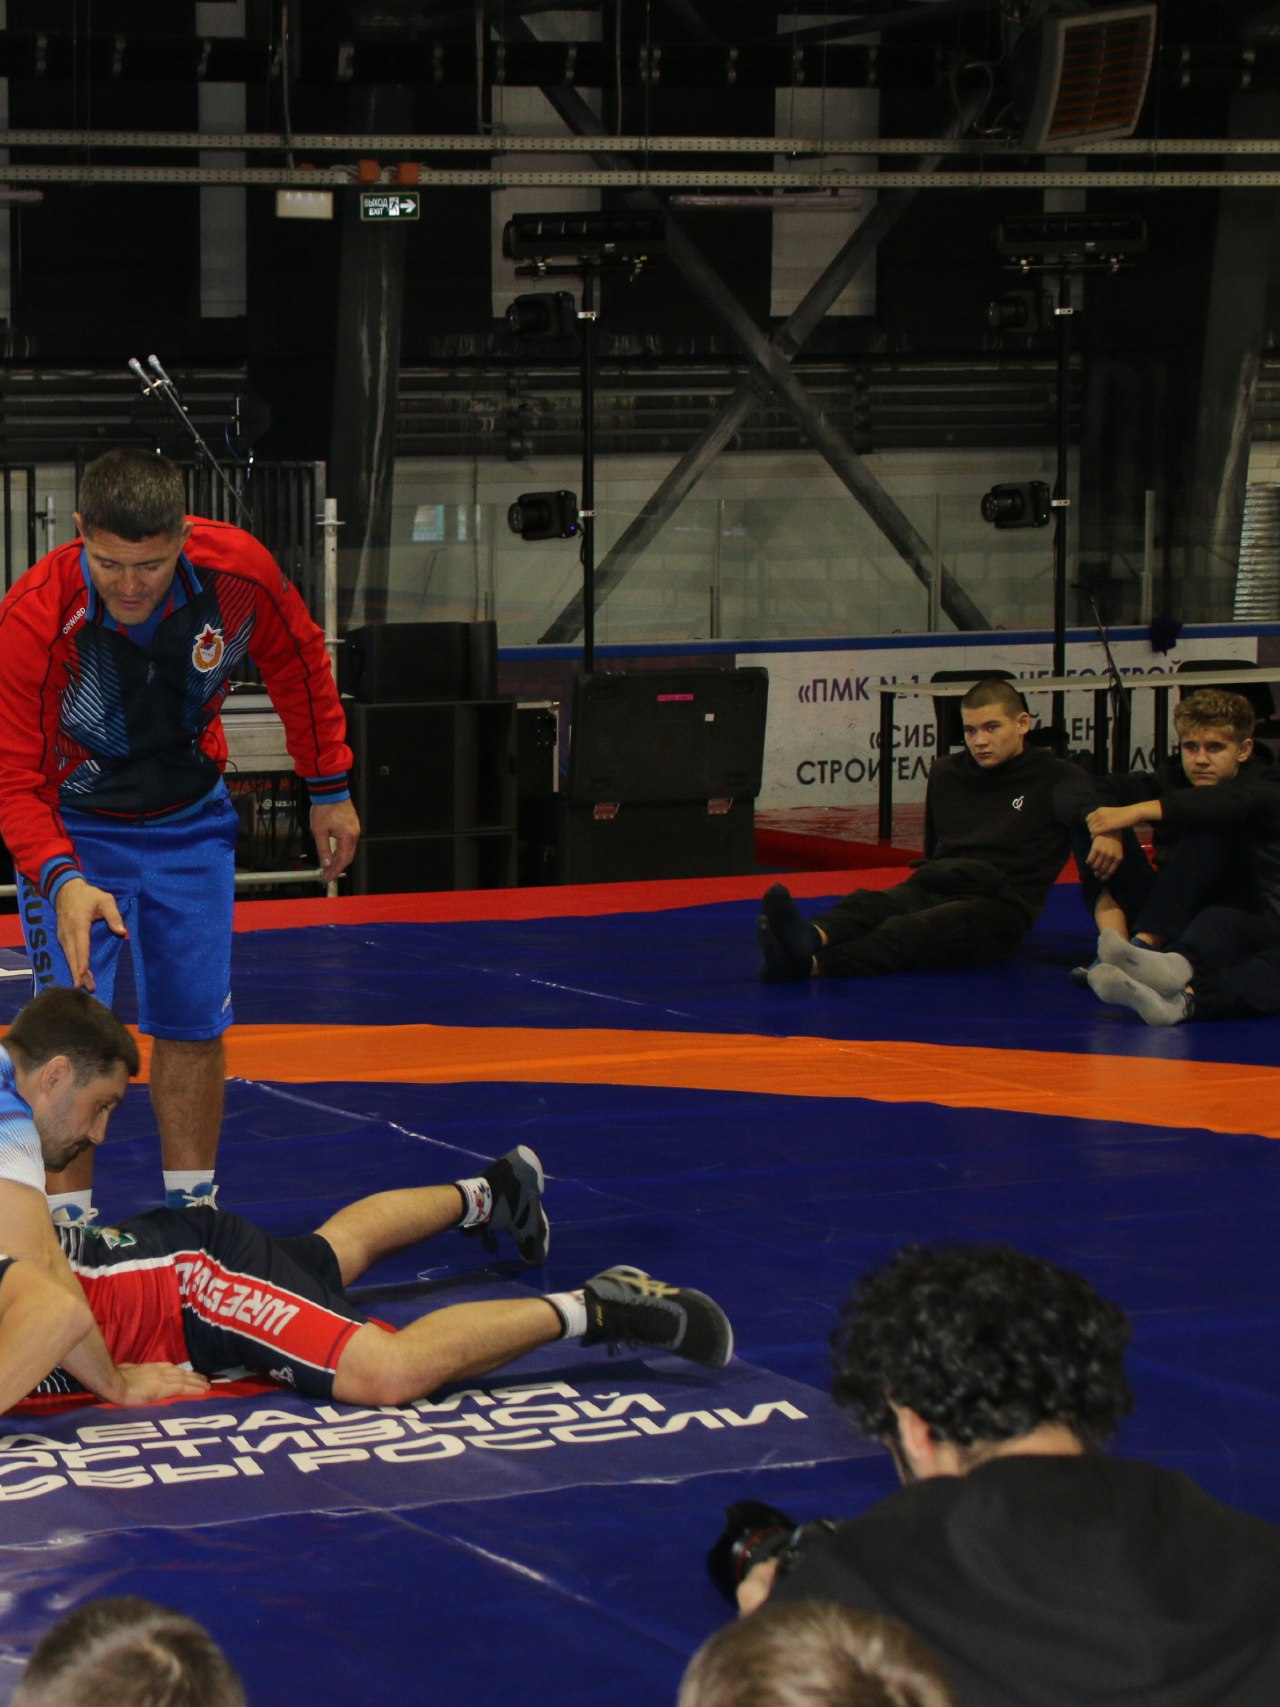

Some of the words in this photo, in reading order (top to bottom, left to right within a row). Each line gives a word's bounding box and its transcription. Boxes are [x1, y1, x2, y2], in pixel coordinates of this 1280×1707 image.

[368, 207, 384, 216] EXIT
[22, 876, 55, 985] RUSSI
[288, 1400, 808, 1473] РОССИИ
